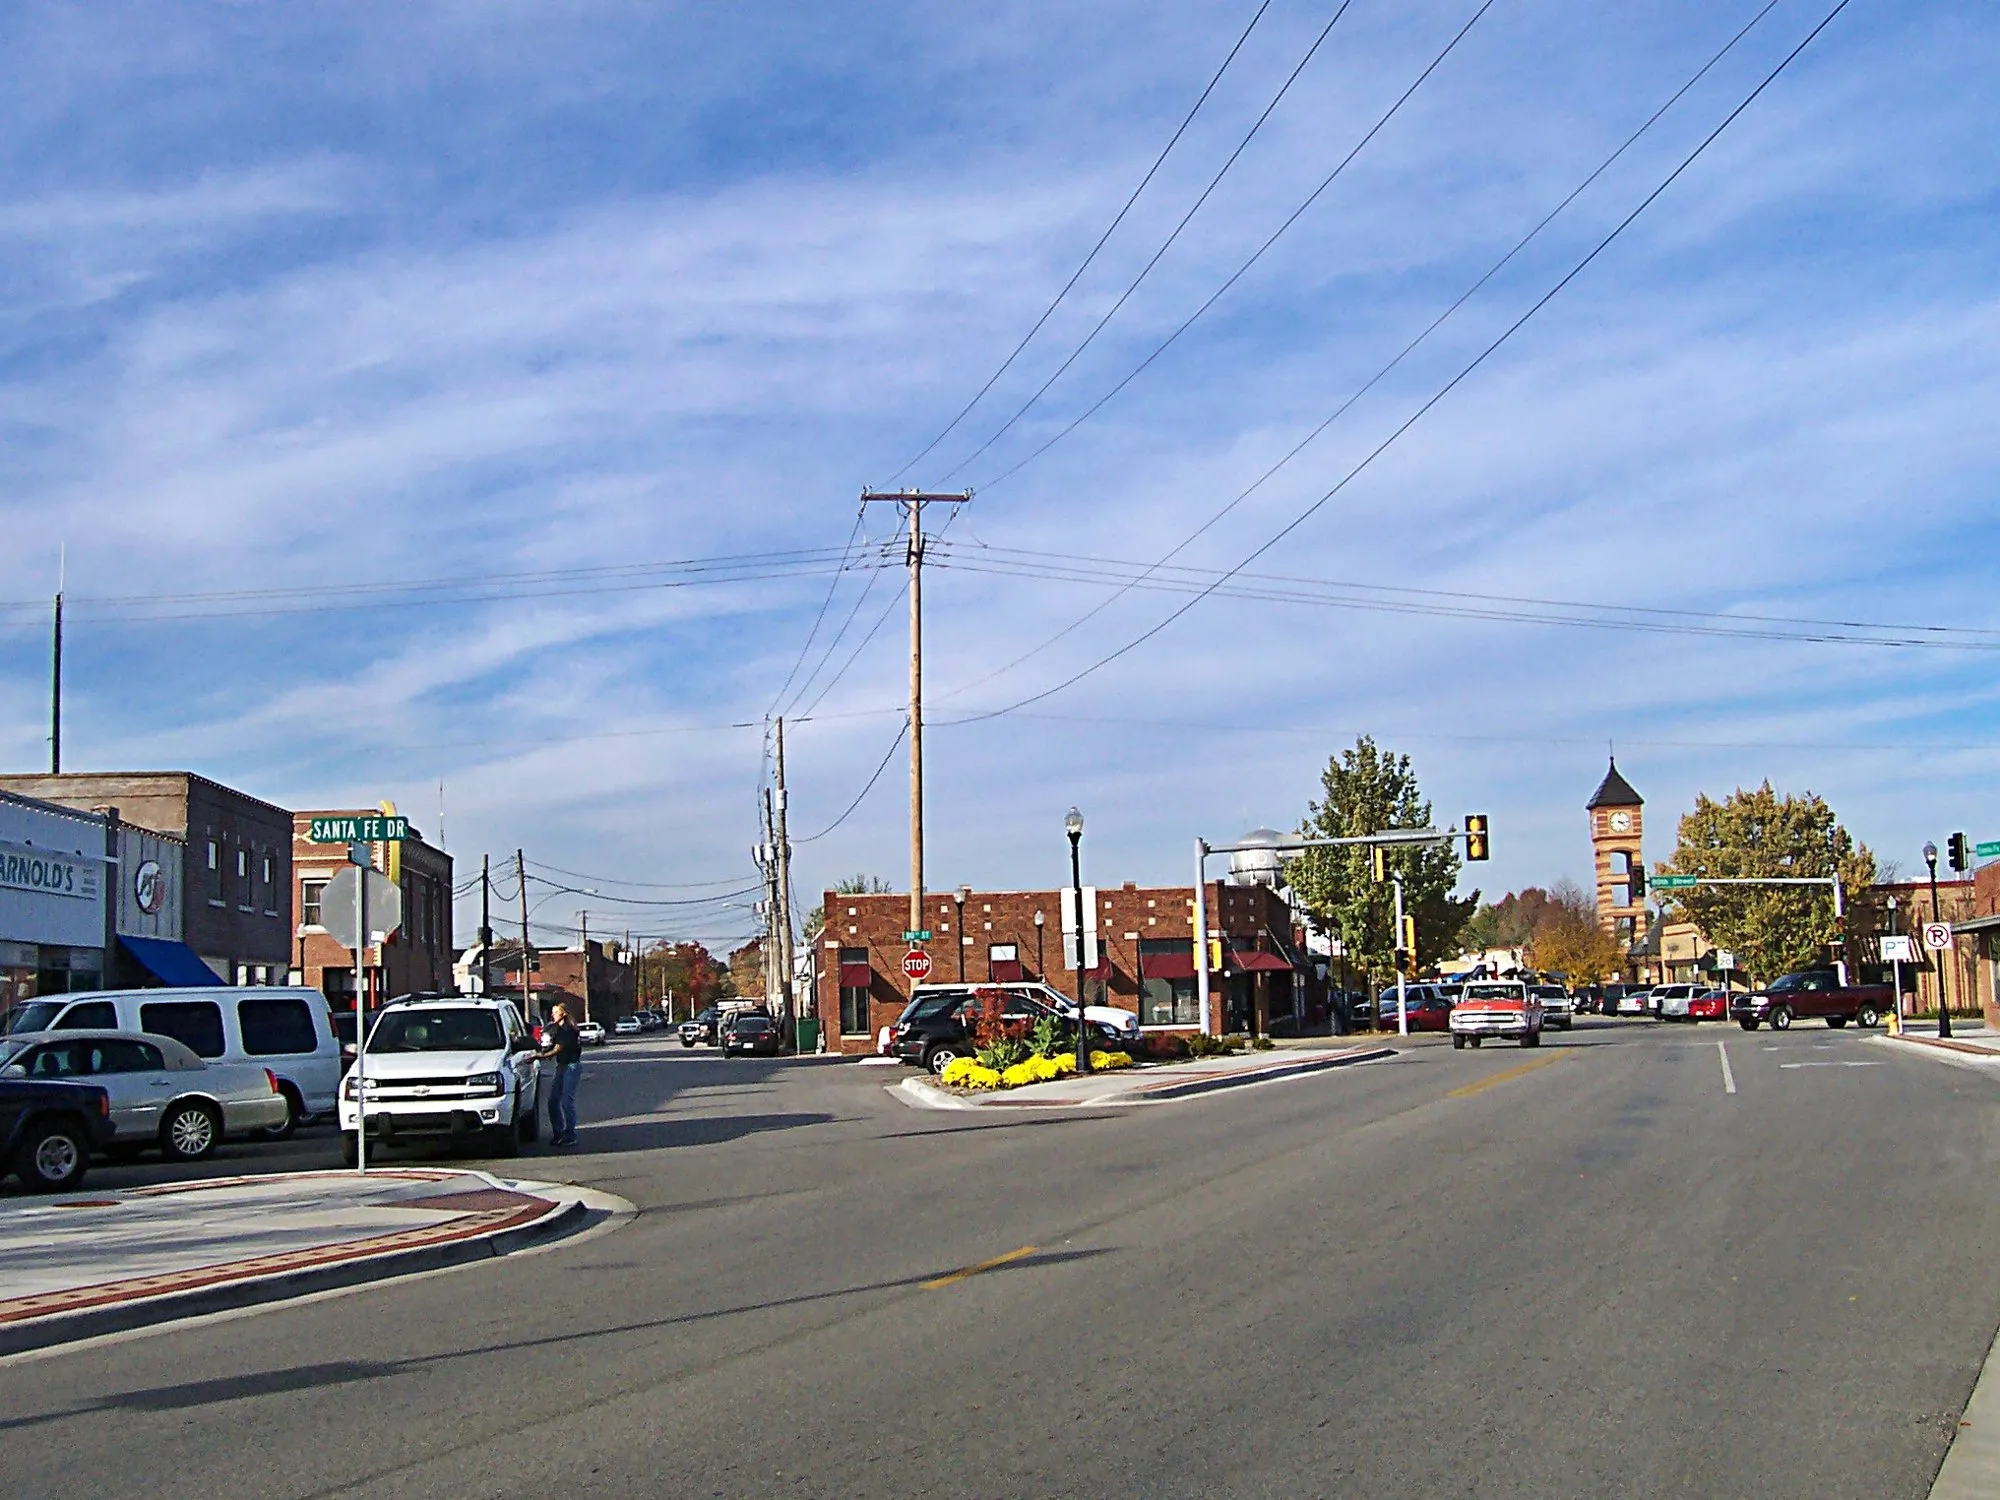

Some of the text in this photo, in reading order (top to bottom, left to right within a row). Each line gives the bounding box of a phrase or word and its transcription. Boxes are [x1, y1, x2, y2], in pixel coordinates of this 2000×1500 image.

[313, 819, 405, 839] SANTA FE DR
[1885, 941, 1896, 956] P
[904, 959, 930, 971] STOP
